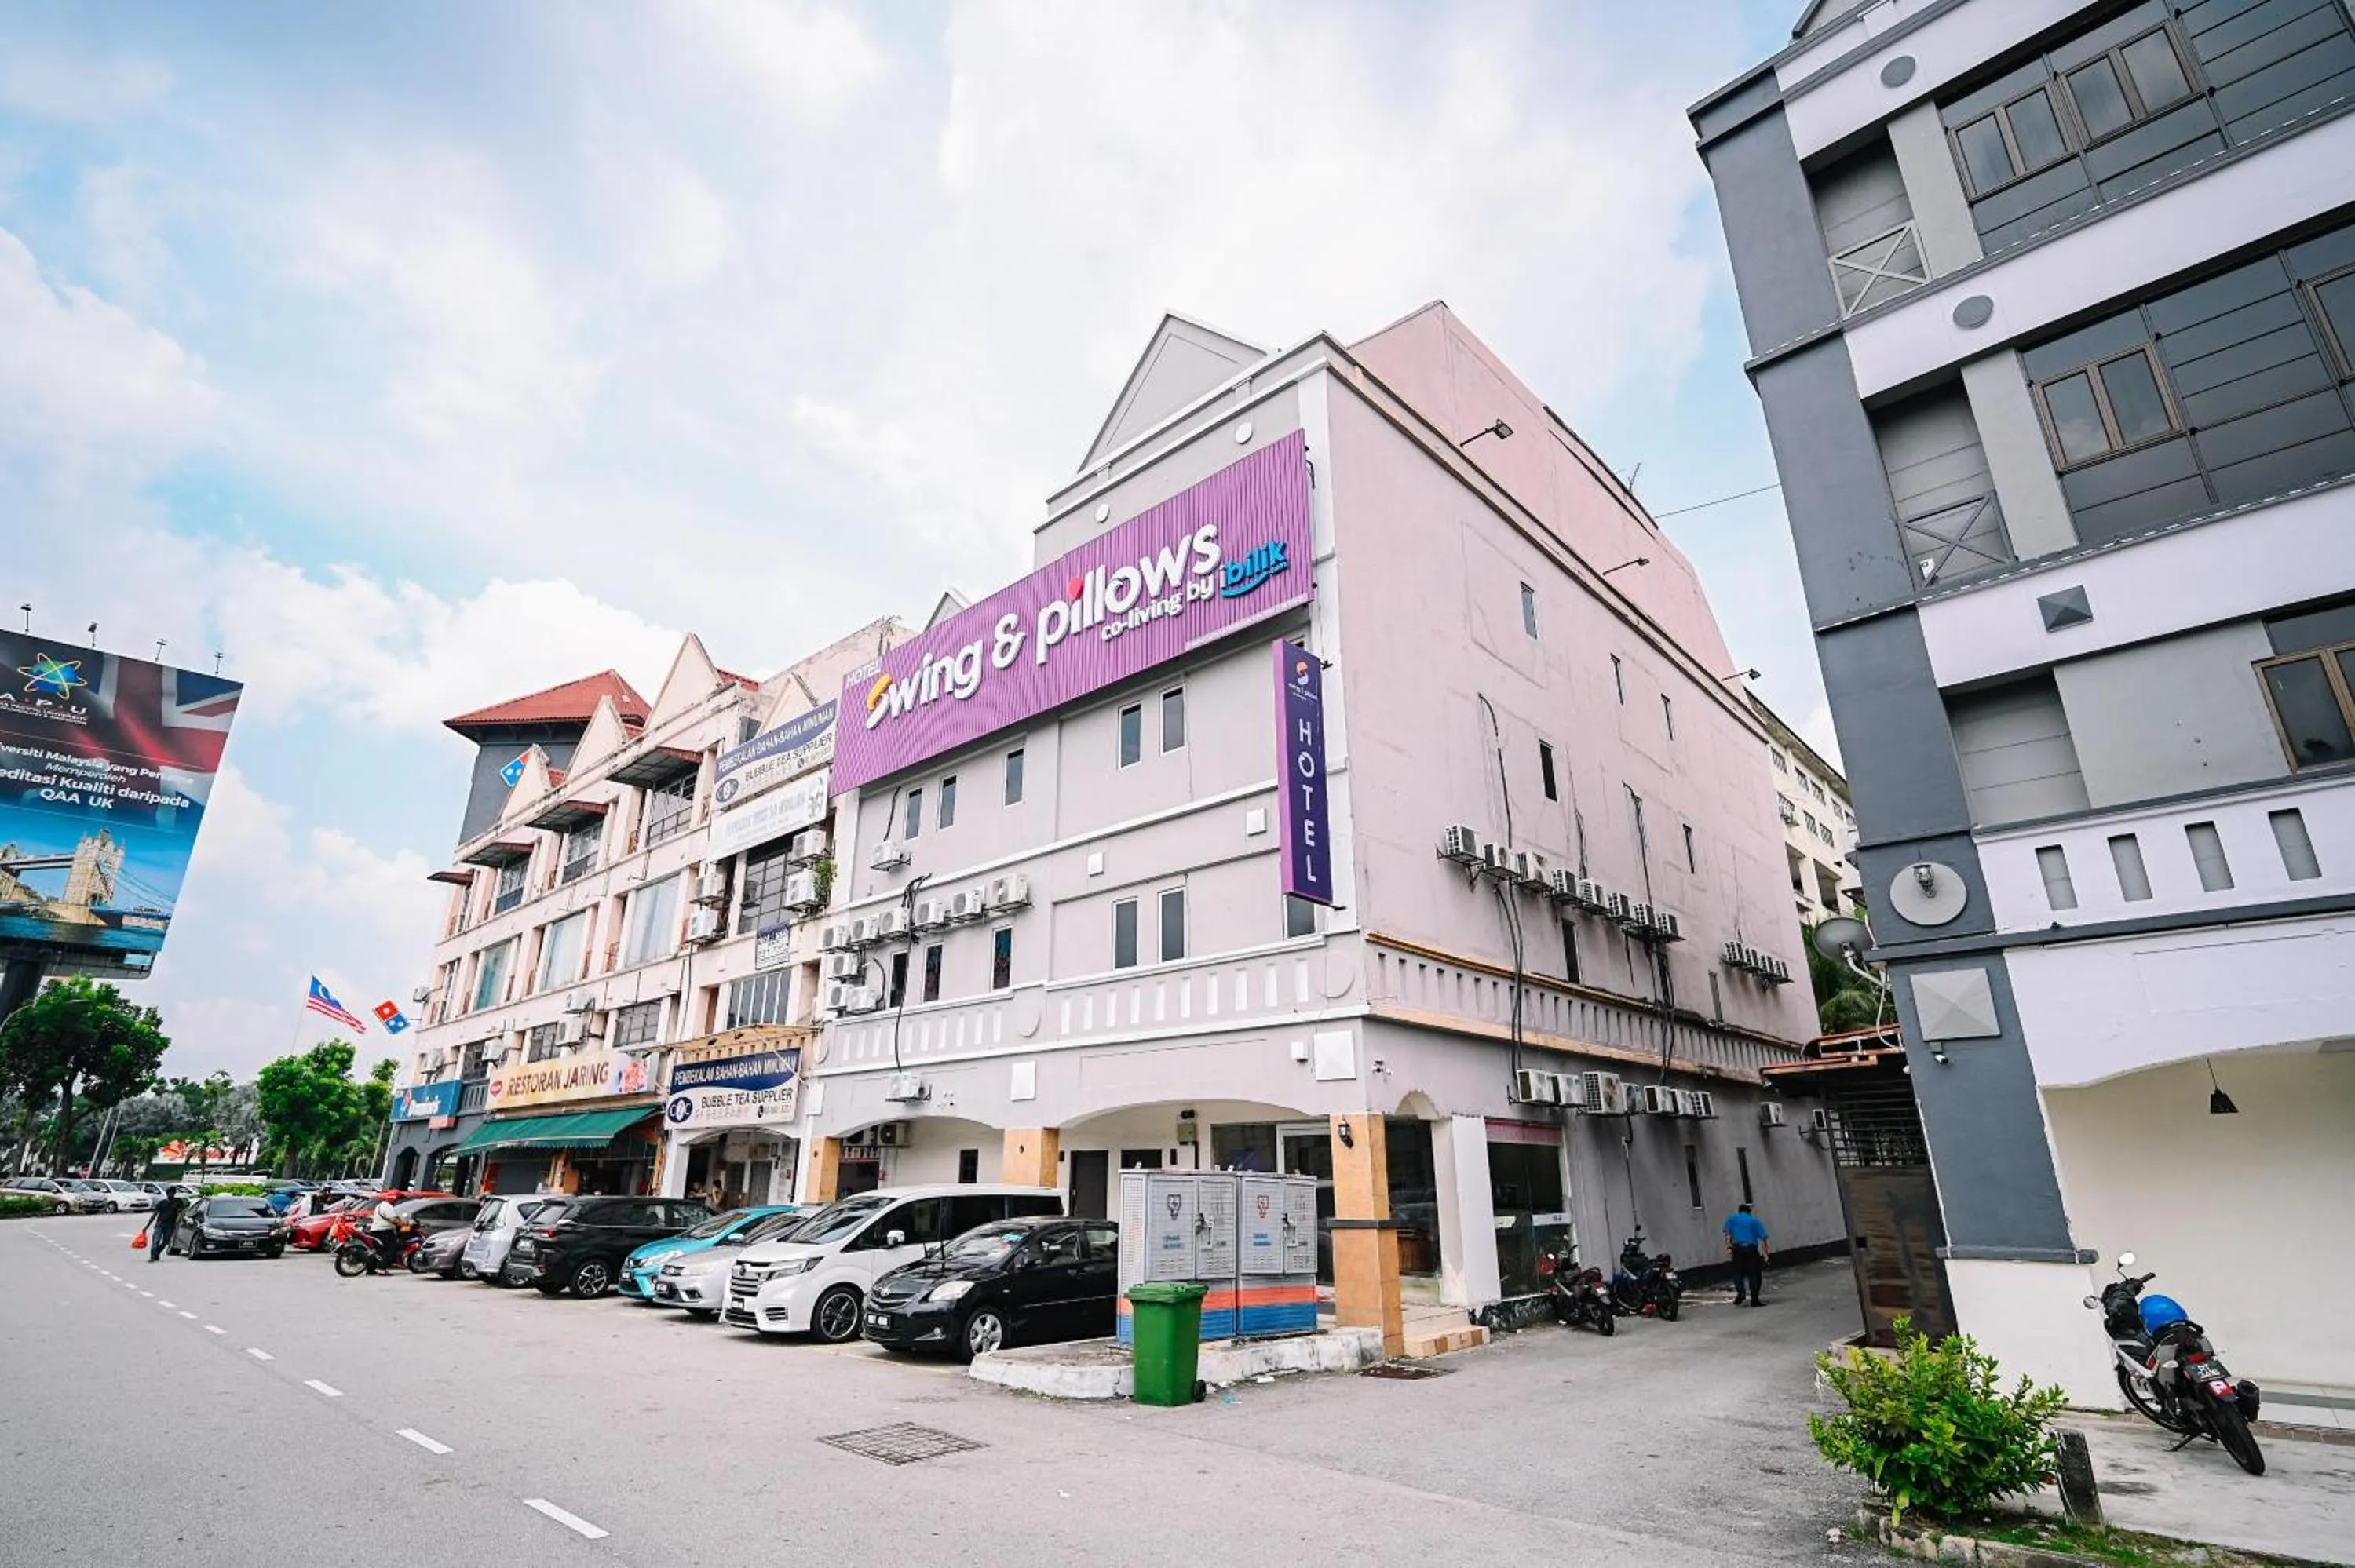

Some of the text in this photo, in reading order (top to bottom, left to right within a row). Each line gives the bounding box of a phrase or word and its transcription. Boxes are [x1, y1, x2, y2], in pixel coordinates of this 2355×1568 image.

[991, 613, 1027, 670] &
[1035, 523, 1222, 665] pillows
[1101, 593, 1184, 642] co-living
[1186, 574, 1215, 603] by
[845, 657, 881, 689] HOTEL
[40, 788, 115, 809] QAA UK
[60, 777, 116, 795] Kualiti
[117, 787, 190, 808] daripada
[1298, 717, 1317, 883] HOTEL
[507, 1069, 562, 1096] RESTORAN
[563, 1062, 609, 1088] JARING
[701, 1092, 732, 1109] BUBBLE
[735, 1092, 750, 1106] TEA
[751, 1087, 794, 1104] SUPPLIER
